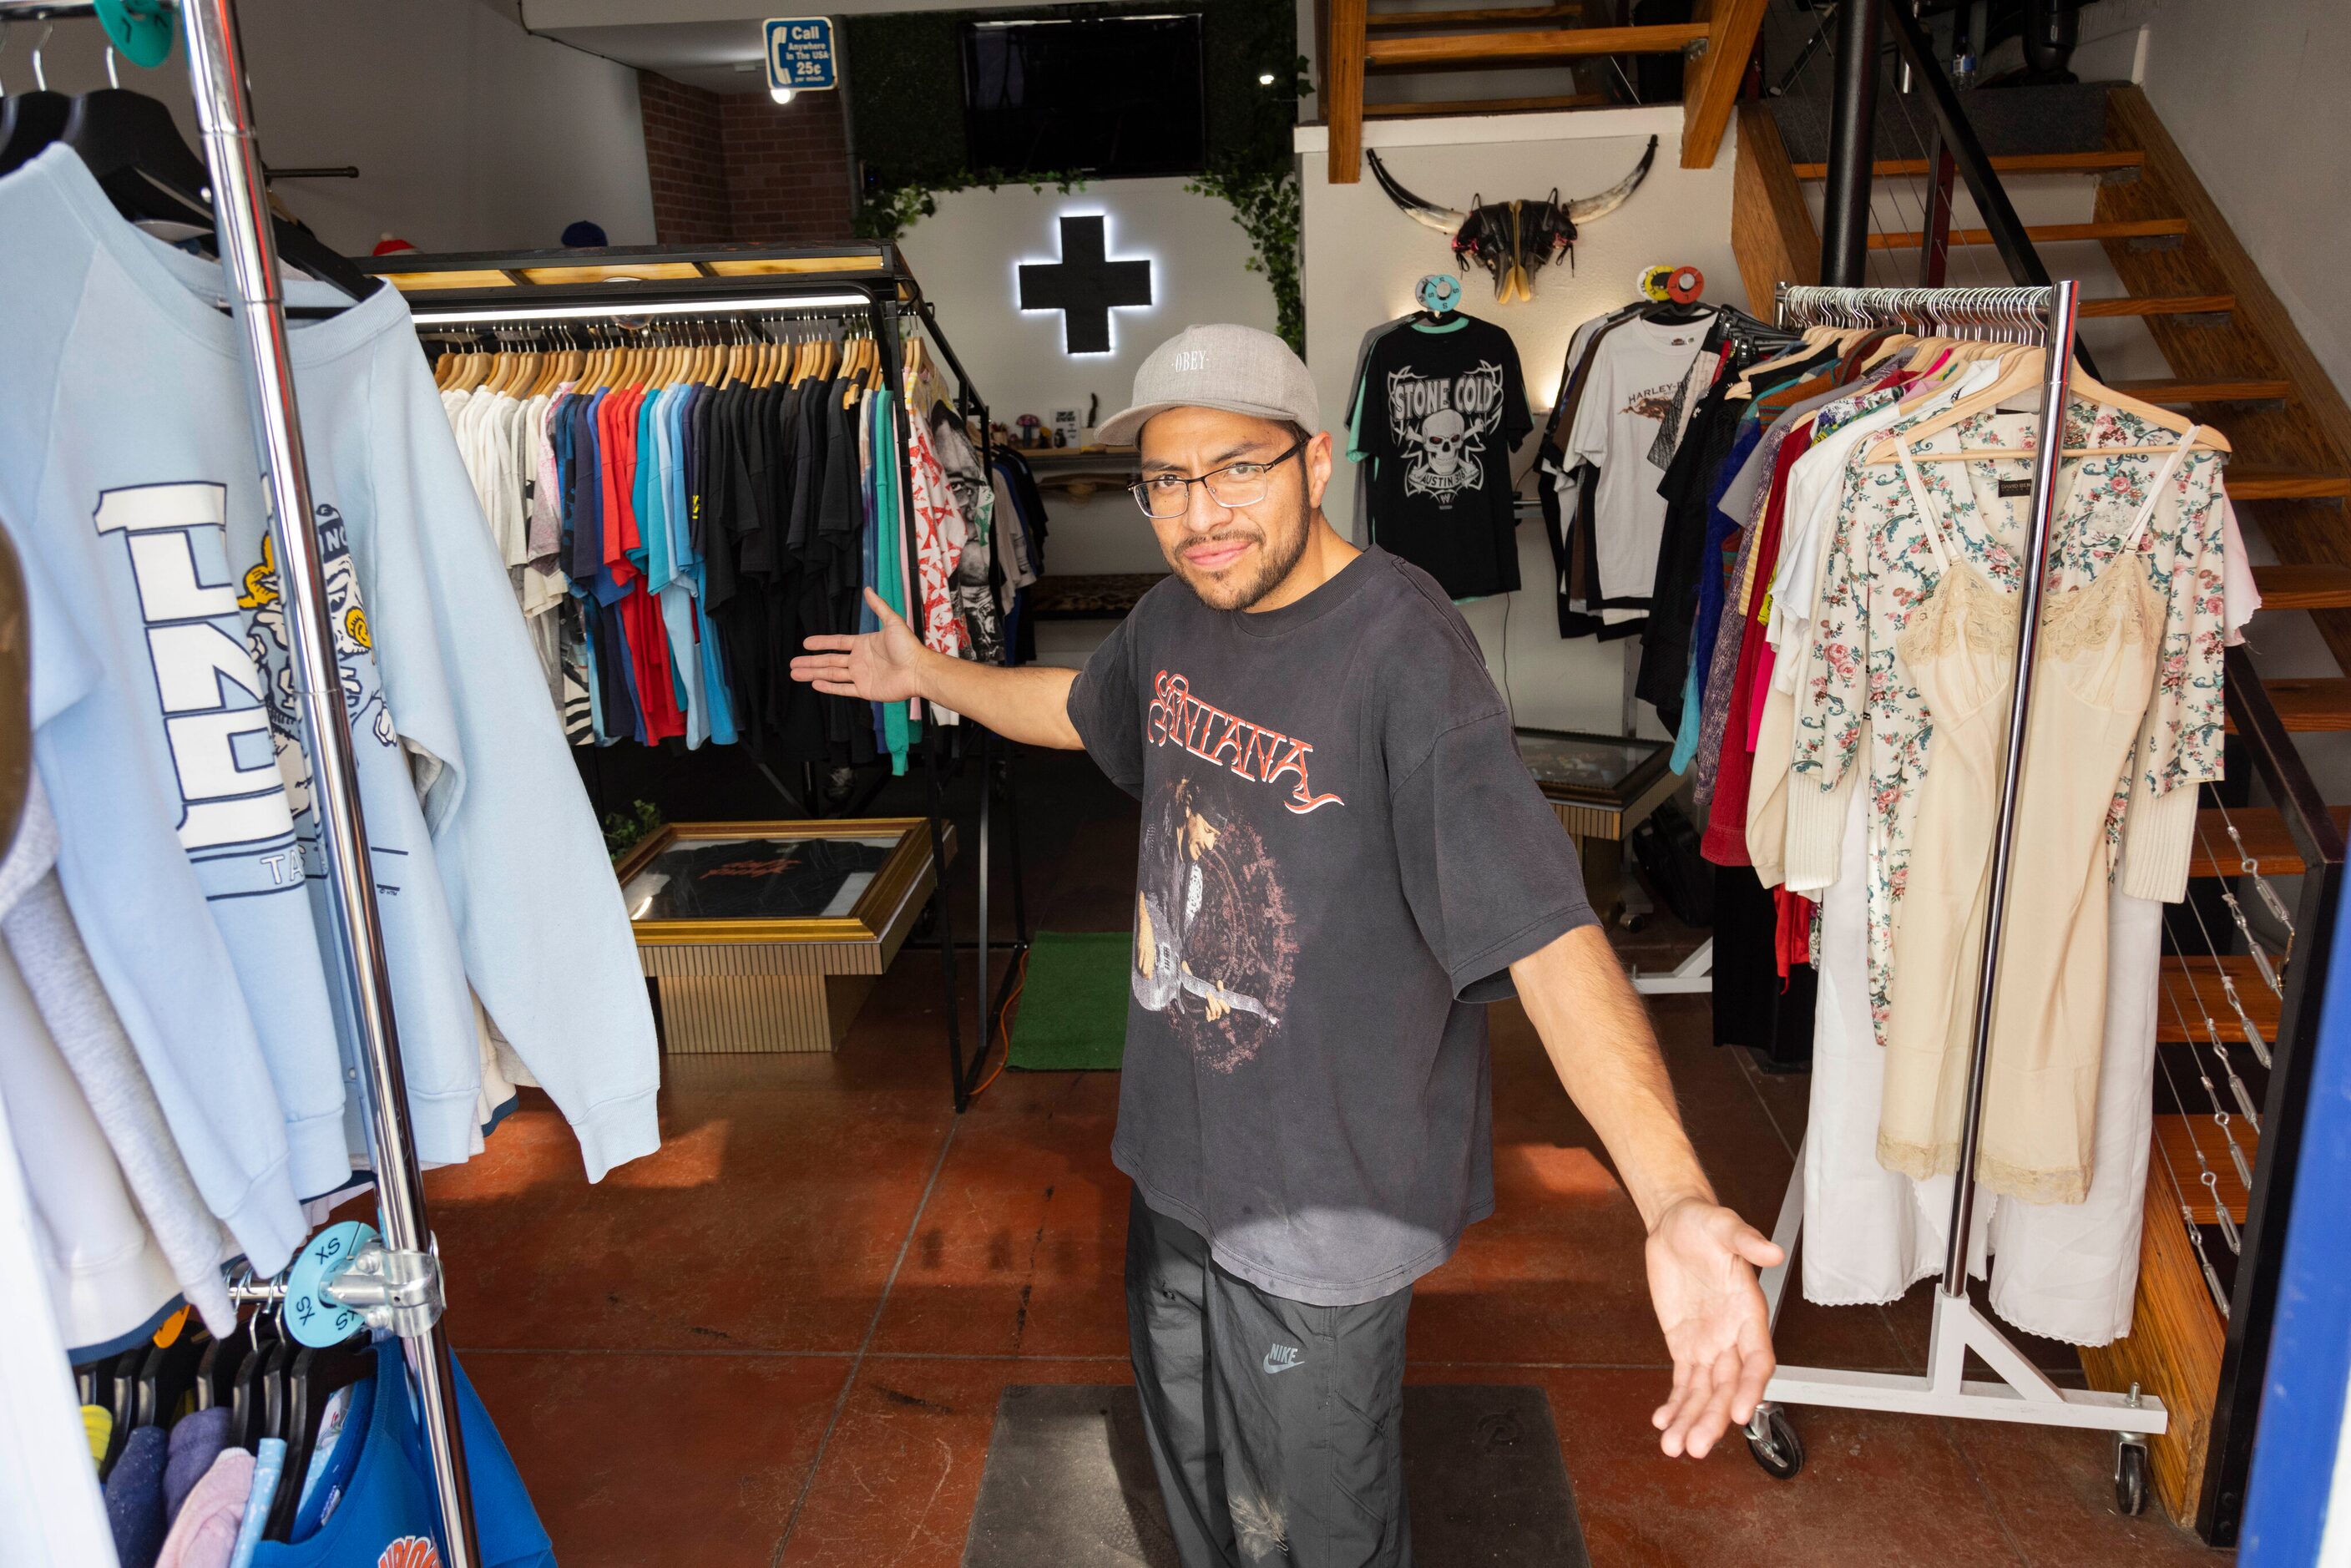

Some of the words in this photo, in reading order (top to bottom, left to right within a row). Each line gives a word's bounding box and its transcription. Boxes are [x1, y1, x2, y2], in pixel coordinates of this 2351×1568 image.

[791, 26, 820, 40] Call
[786, 52, 794, 60] In
[796, 51, 810, 60] The
[811, 51, 829, 59] USA
[787, 43, 826, 52] Anywhere
[1394, 377, 1451, 421] STONE
[1454, 375, 1494, 414] COLD
[1421, 473, 1454, 488] AUSTIN
[1148, 670, 1345, 814] SANTANA
[315, 1237, 341, 1265] XS
[296, 1296, 315, 1326] XS
[1269, 1343, 1298, 1364] NIKE
